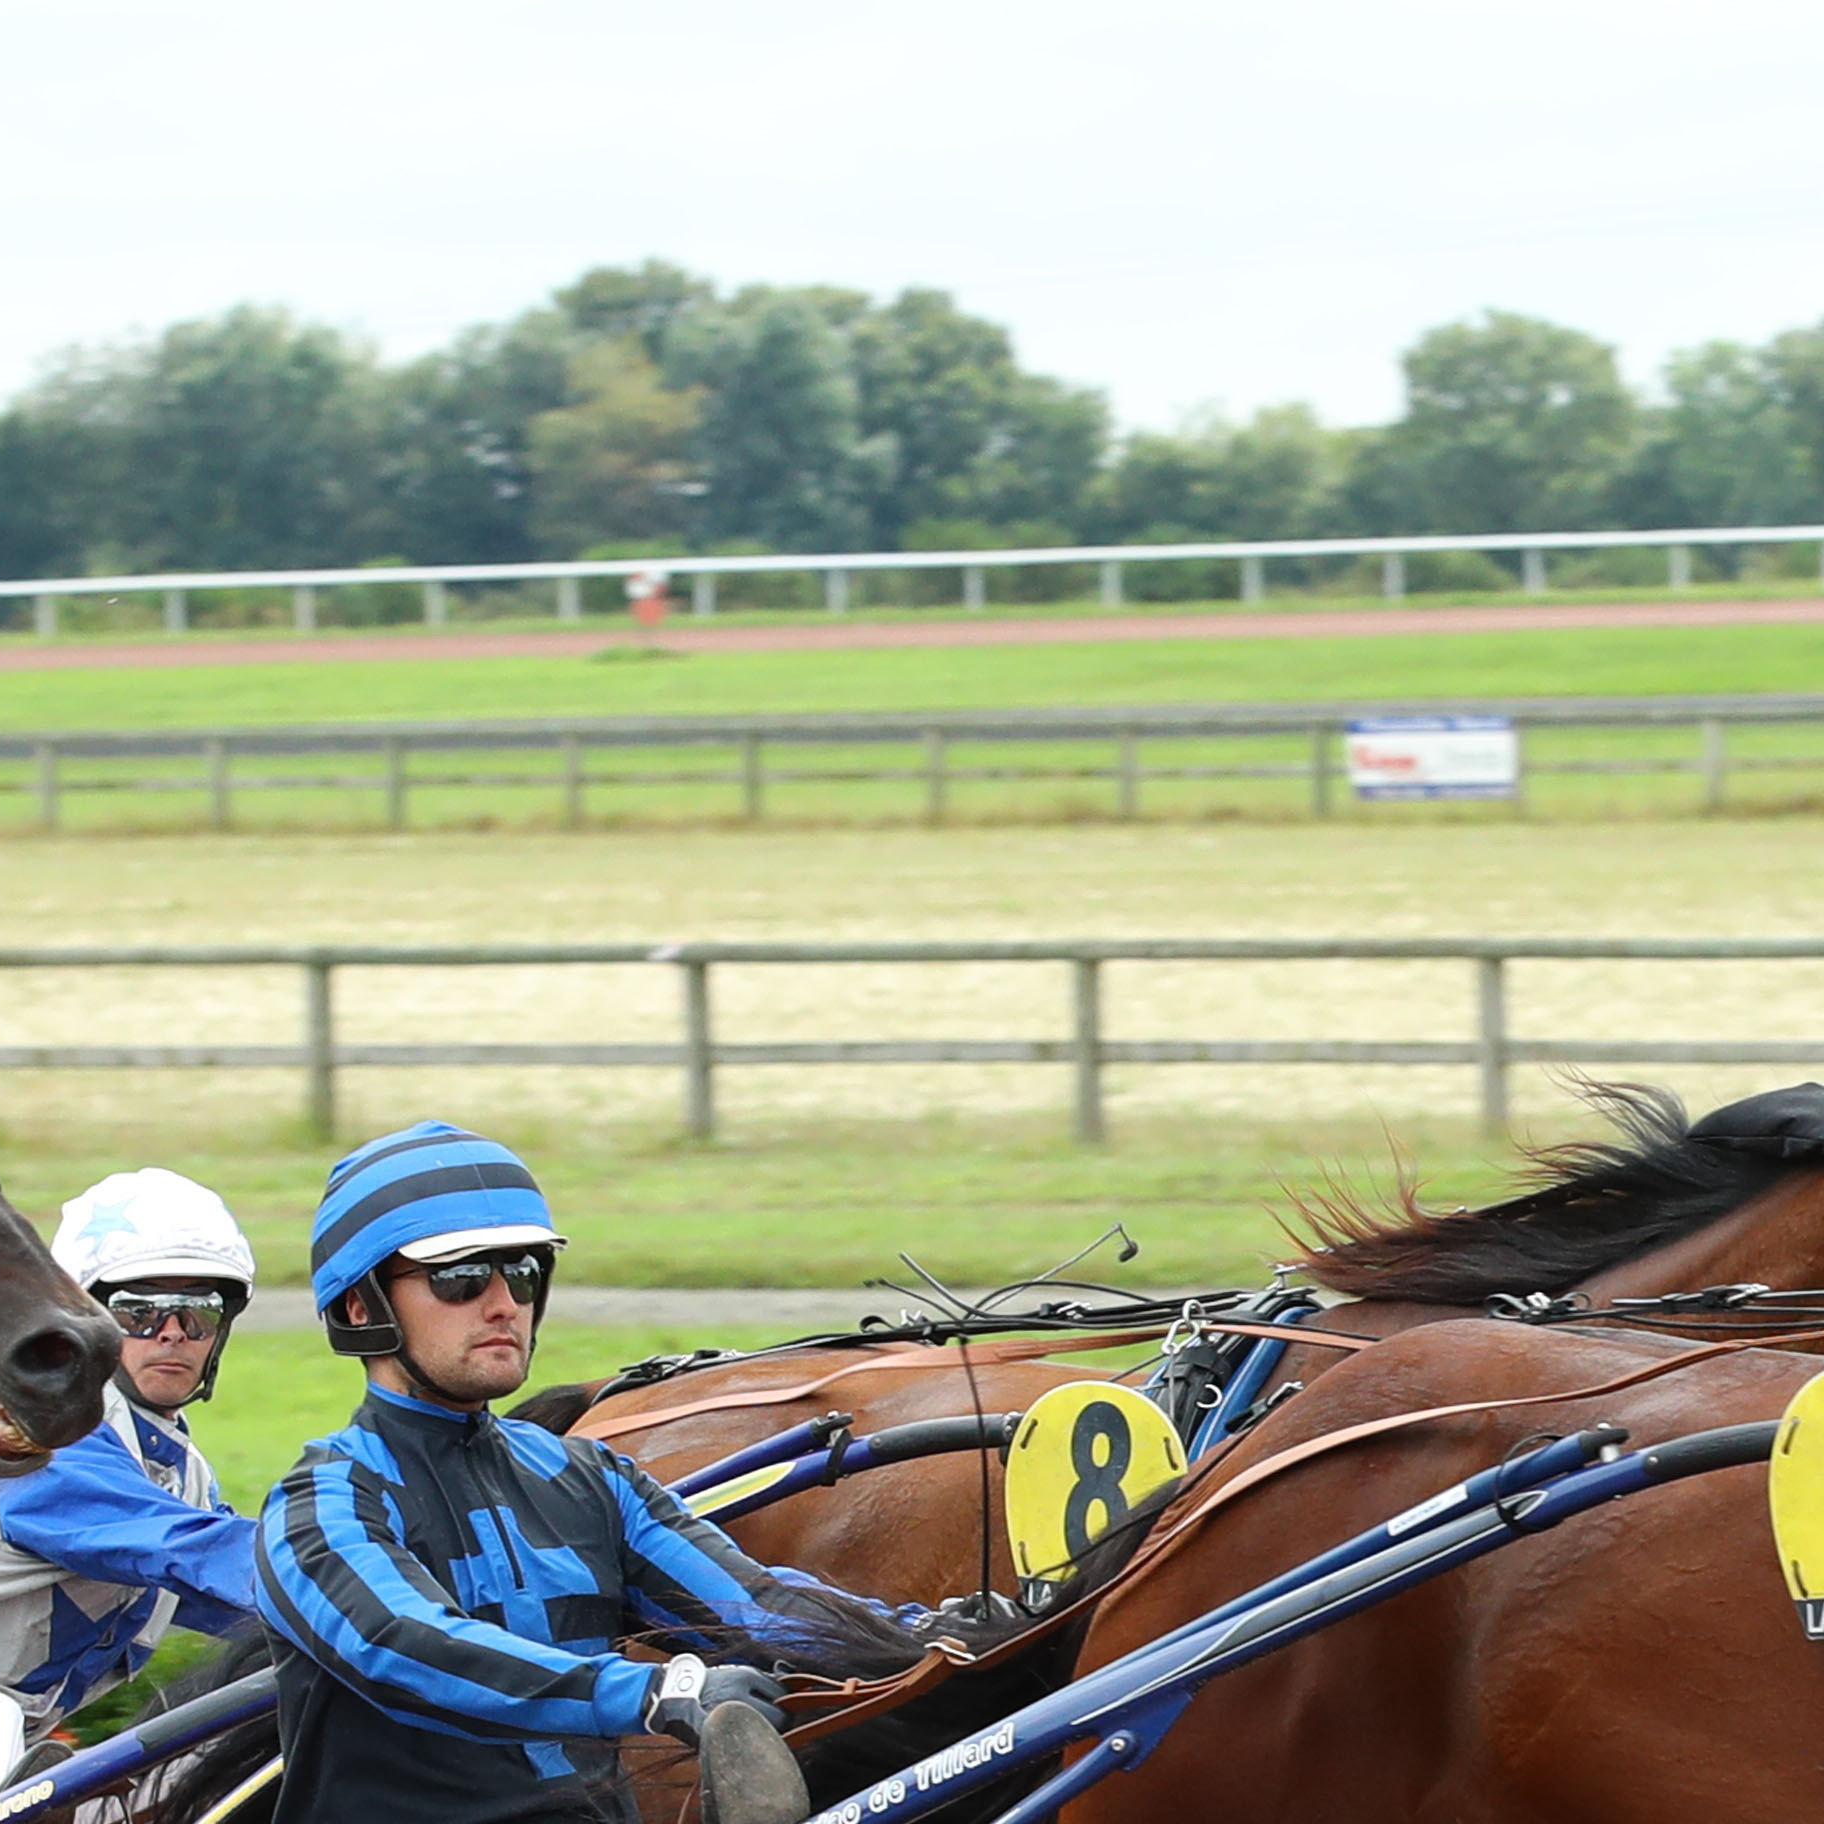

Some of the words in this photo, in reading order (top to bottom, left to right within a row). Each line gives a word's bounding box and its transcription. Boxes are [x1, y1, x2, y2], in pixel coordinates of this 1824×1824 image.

[1064, 1400, 1131, 1560] 8
[868, 1778, 907, 1814] de
[914, 1721, 1017, 1792] Tillard
